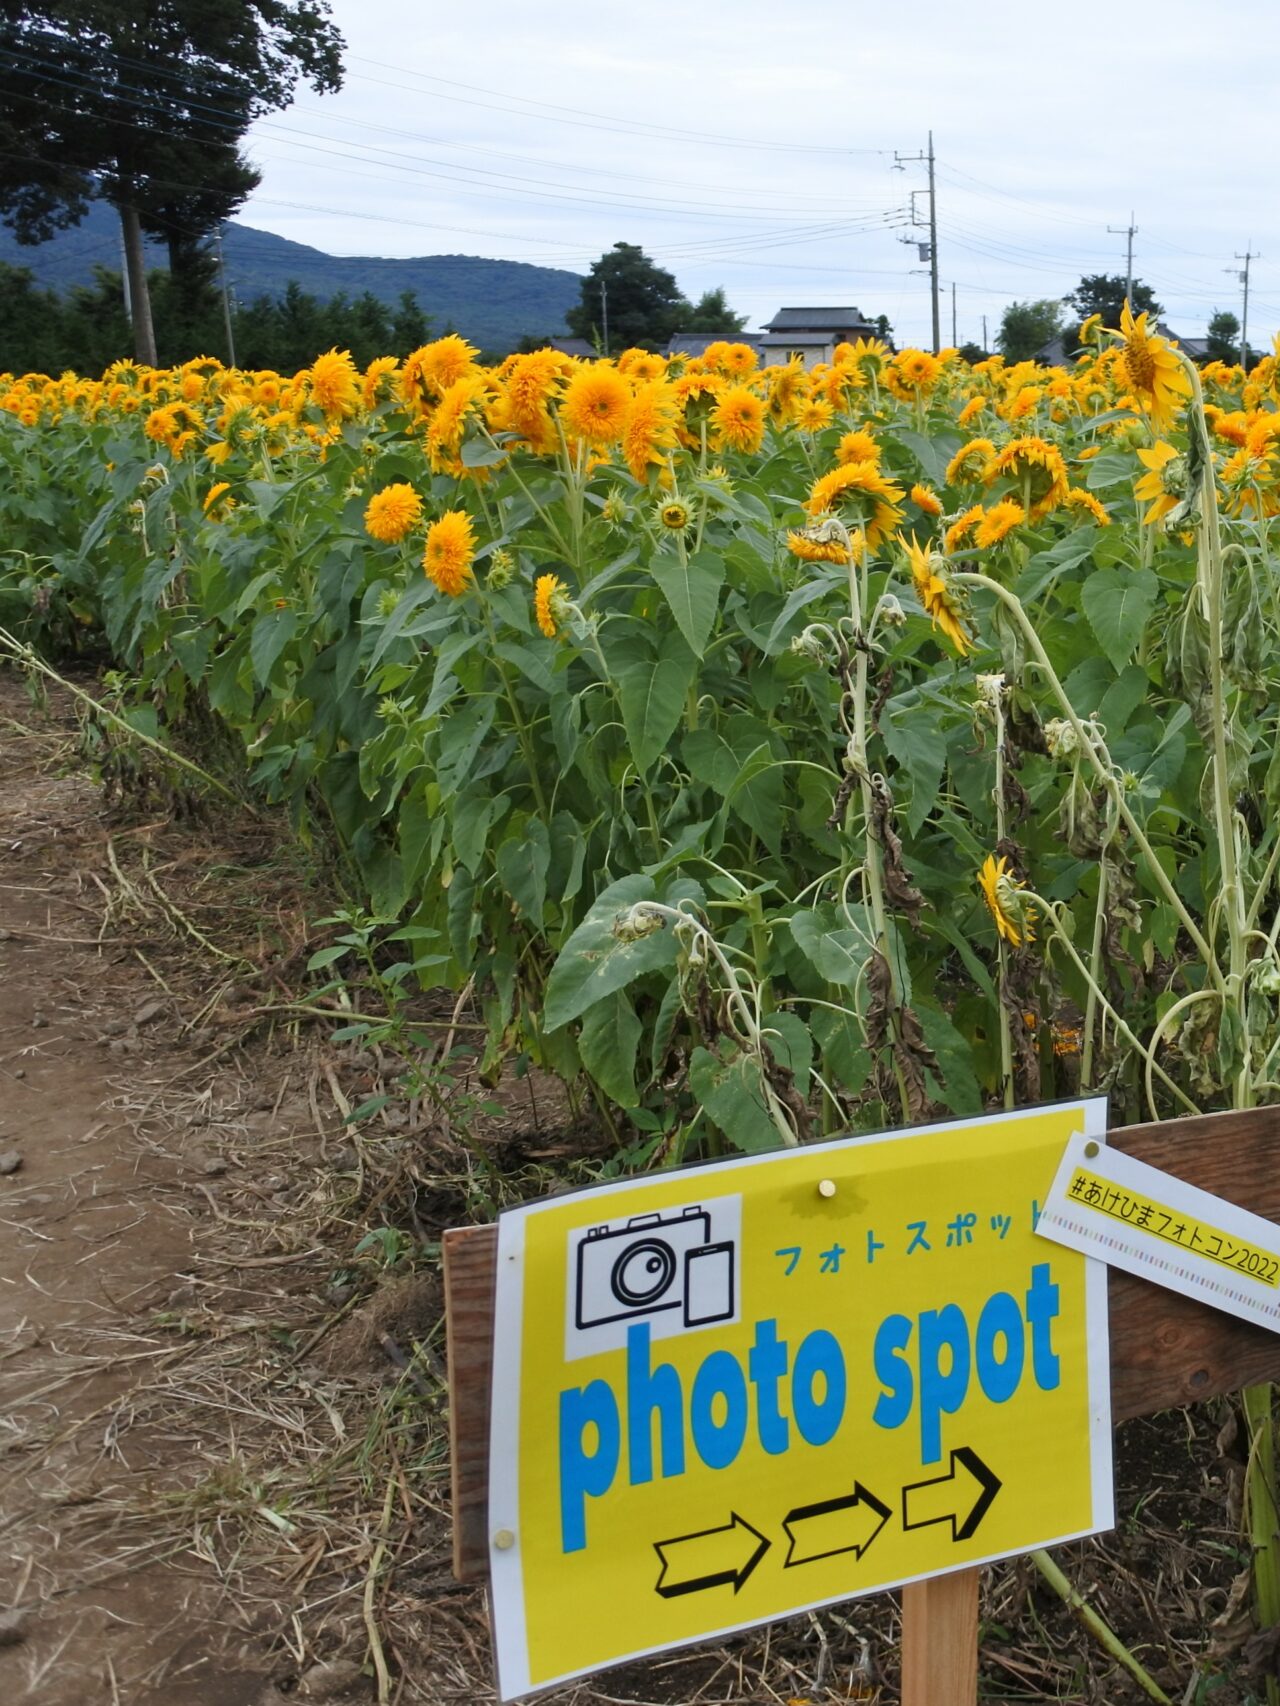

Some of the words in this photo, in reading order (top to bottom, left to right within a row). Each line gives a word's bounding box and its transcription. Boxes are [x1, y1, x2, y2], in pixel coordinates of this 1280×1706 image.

[1071, 1176, 1280, 1282] #あけひまフォトコン2022
[559, 1320, 846, 1553] photo
[873, 1263, 1060, 1464] spot
